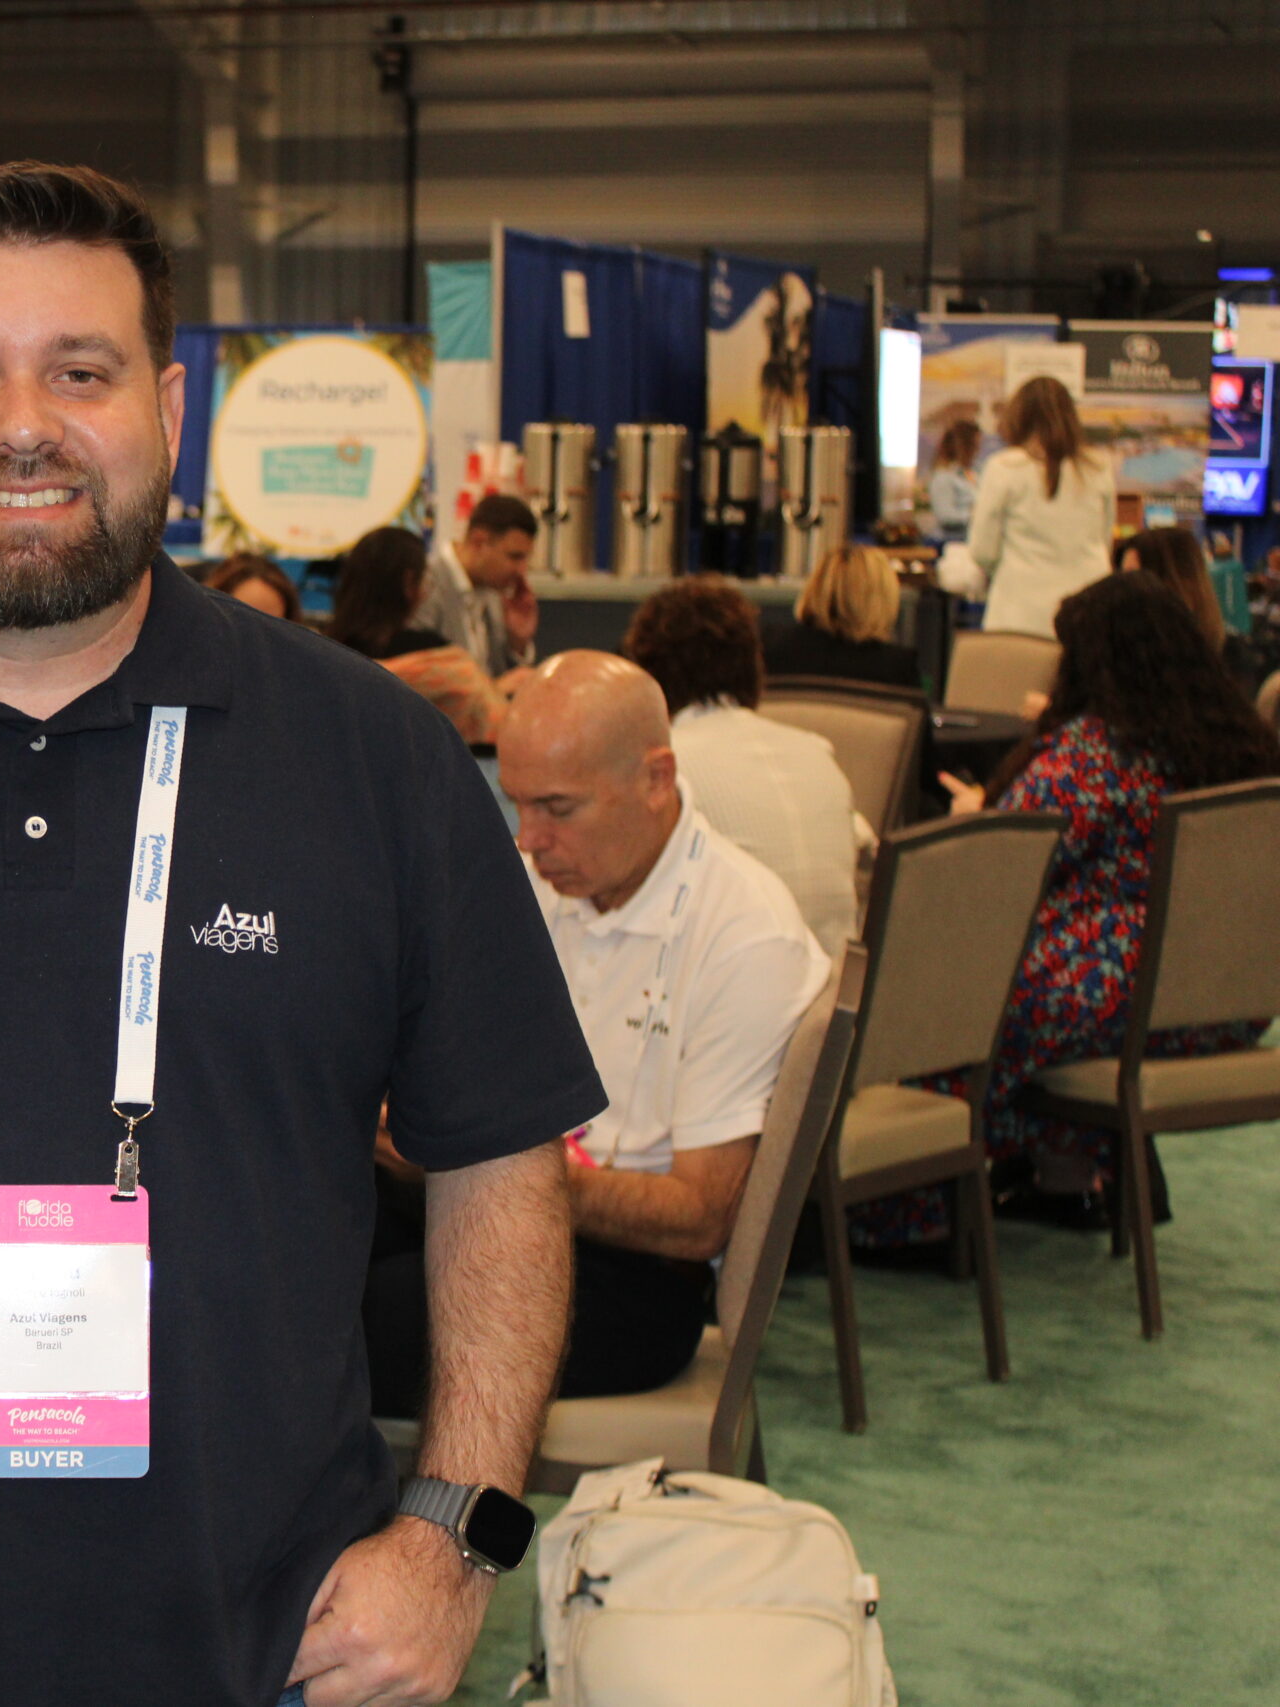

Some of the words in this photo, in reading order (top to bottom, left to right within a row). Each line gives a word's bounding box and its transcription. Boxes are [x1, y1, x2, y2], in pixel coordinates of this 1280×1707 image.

[157, 719, 179, 787] Pensacola
[144, 833, 166, 903] Pensacola
[214, 903, 276, 935] Azul
[190, 921, 279, 954] viagens
[134, 951, 155, 1026] Pensacola
[18, 1213, 74, 1227] huddle
[10, 1313, 36, 1323] Azul
[39, 1313, 87, 1325] Viagens
[60, 1328, 73, 1337] SP
[36, 1341, 62, 1350] Brazil
[8, 1406, 86, 1426] Pensacola
[10, 1451, 84, 1467] BUYER
